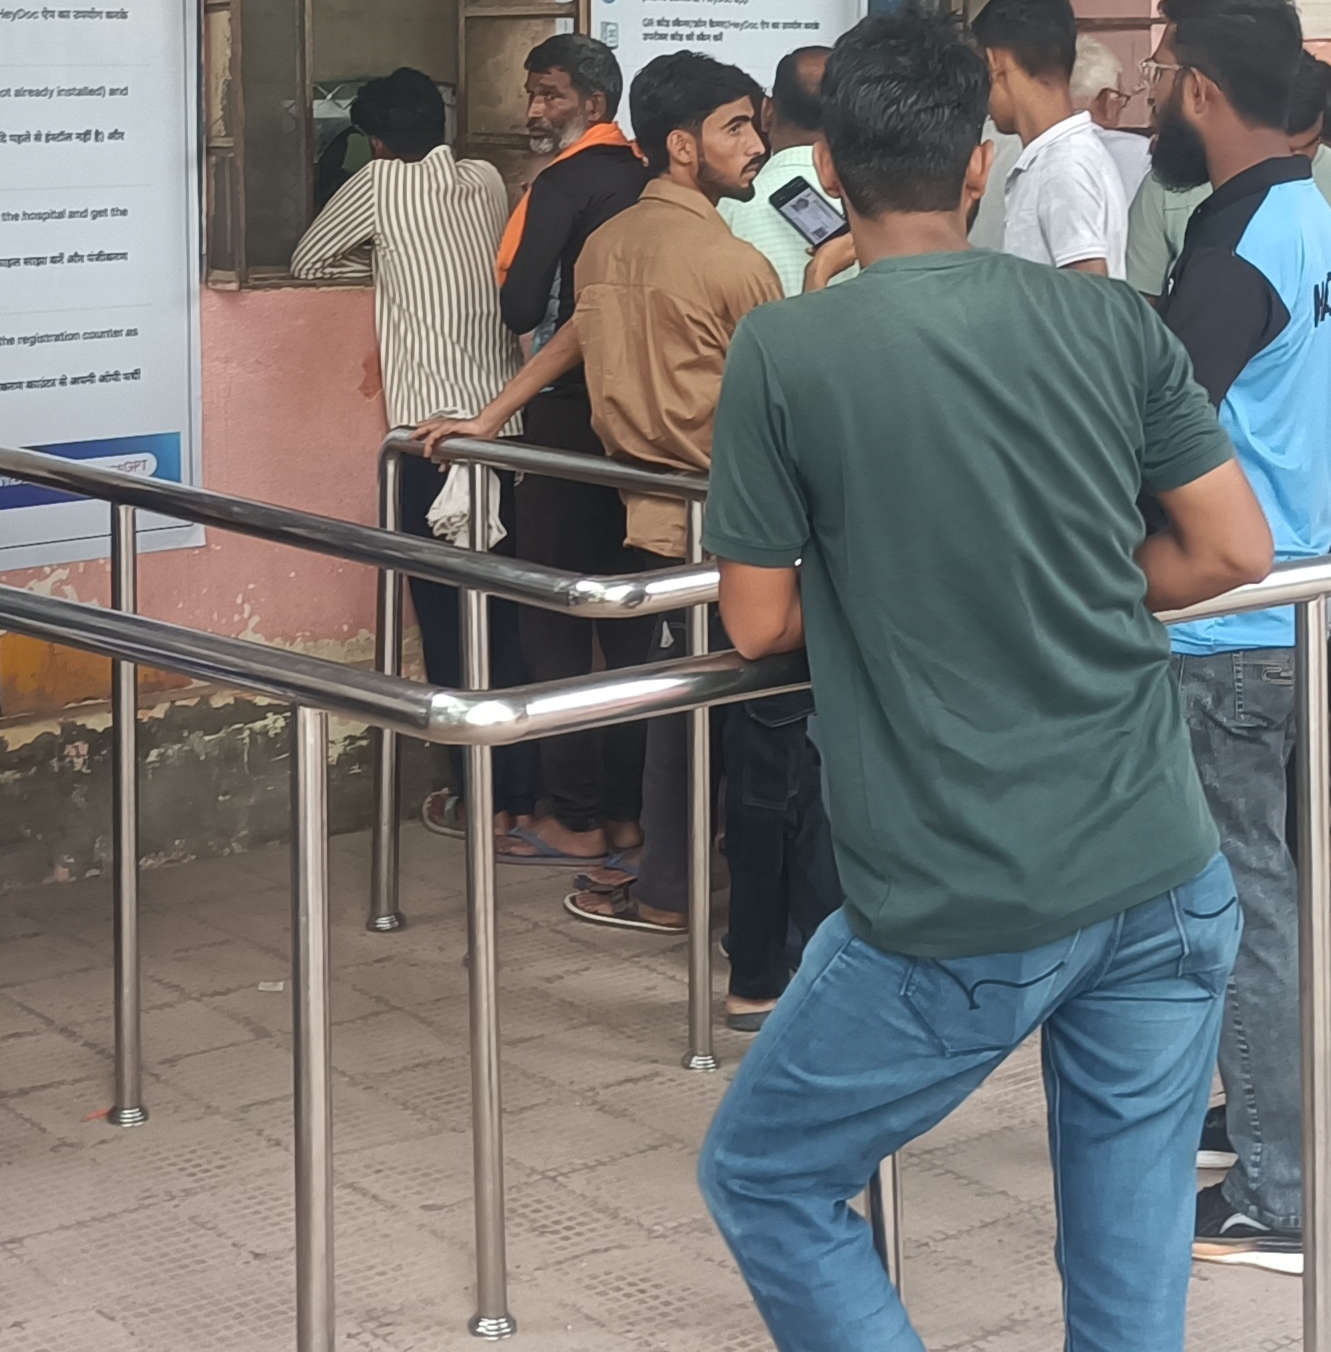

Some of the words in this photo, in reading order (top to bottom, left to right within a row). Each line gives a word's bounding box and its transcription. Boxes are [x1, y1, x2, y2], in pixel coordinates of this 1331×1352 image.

[14, 86, 55, 99] already
[109, 86, 129, 97] and
[1, 210, 20, 223] the
[22, 208, 67, 223] hospital
[68, 208, 89, 220] and
[90, 207, 109, 221] get
[110, 206, 129, 218] the
[17, 332, 80, 347] registration
[82, 328, 124, 340] counter
[125, 328, 139, 338] as
